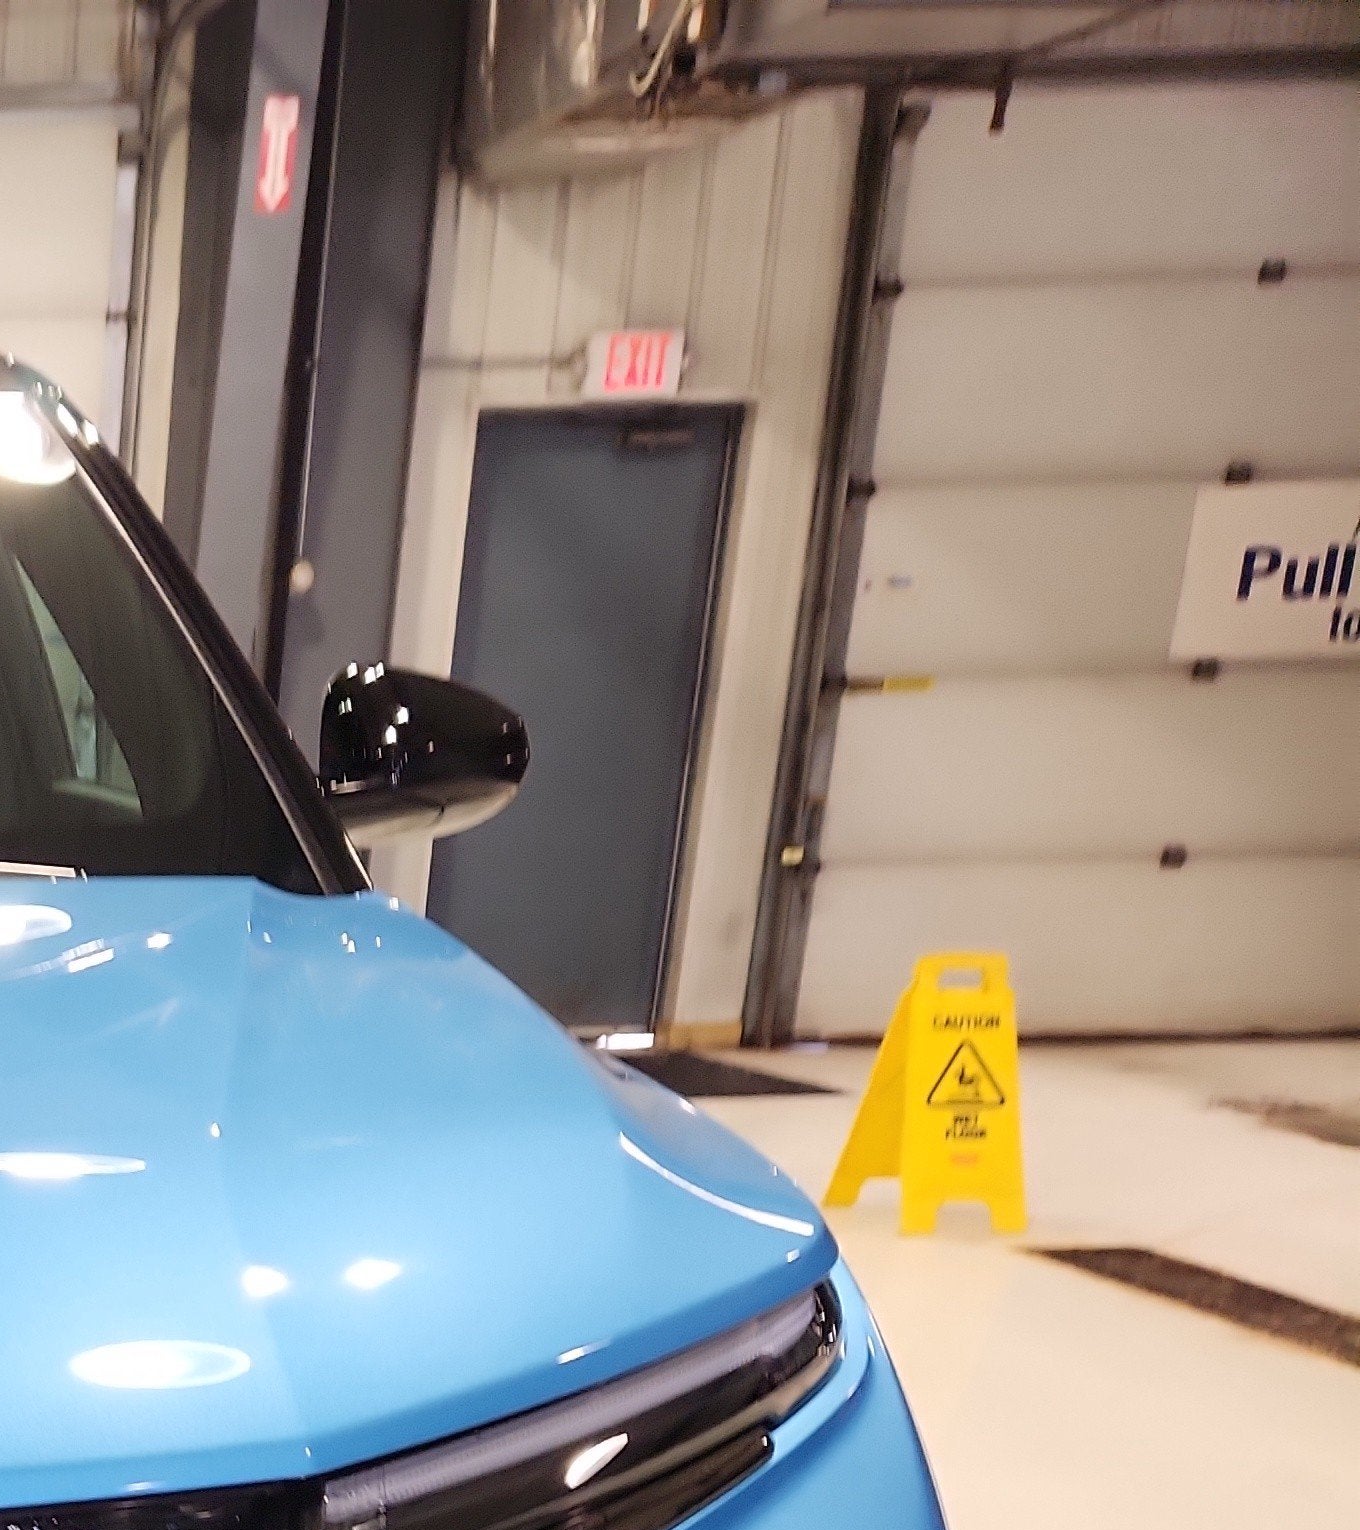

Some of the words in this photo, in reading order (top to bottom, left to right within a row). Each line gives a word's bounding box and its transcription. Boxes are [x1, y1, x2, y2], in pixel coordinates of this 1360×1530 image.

[604, 331, 673, 393] EXIT
[1236, 543, 1357, 600] Pull
[933, 1014, 1001, 1029] CAUTION
